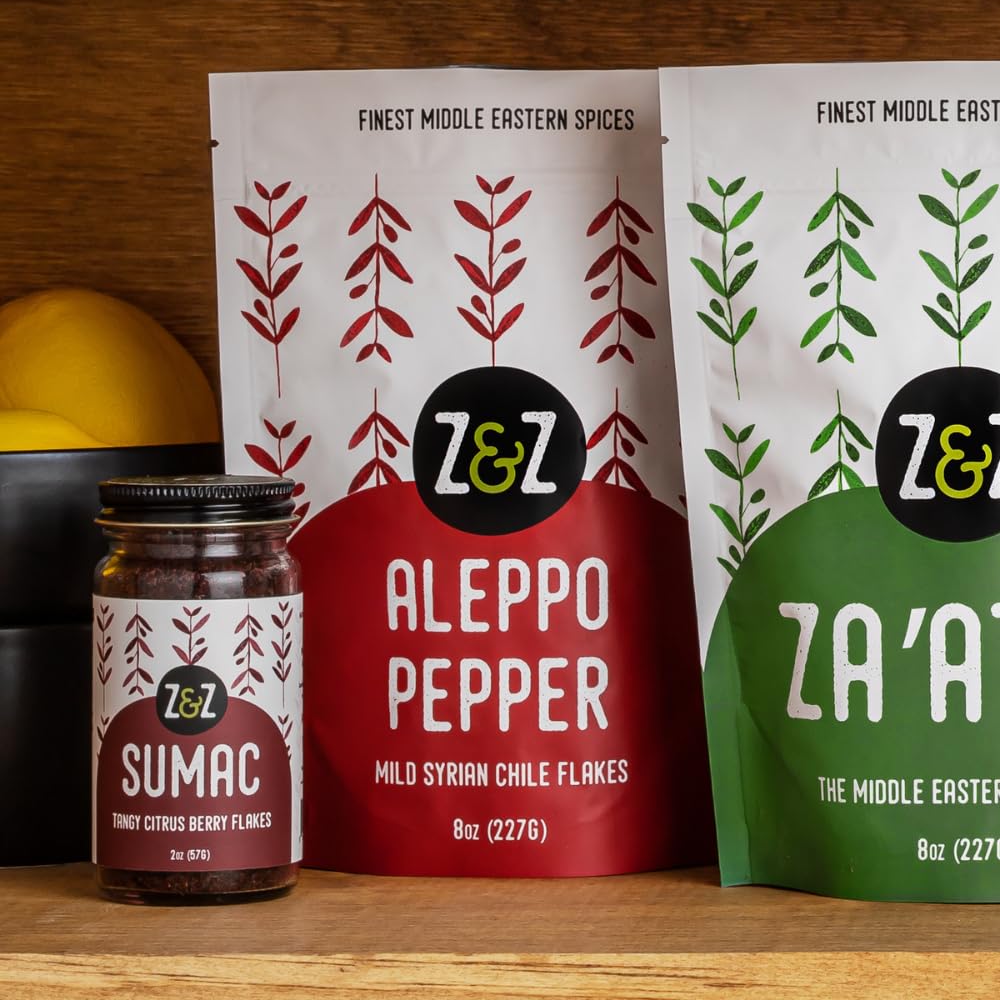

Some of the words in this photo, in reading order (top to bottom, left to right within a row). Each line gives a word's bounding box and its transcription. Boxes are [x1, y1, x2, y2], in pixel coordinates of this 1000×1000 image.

[359, 109, 414, 131] FINEST
[421, 108, 484, 129] MIDDLE
[492, 108, 567, 130] EASTERN
[574, 109, 635, 131] SPICES
[818, 101, 876, 123] FINEST
[884, 100, 949, 122] MIDDLE
[435, 411, 557, 494] Z&Z
[387, 557, 608, 632] ALEPPO
[165, 683, 216, 718] Z&Z
[389, 657, 608, 732] PEPPER
[123, 742, 259, 798] SUMAC
[376, 760, 416, 785] MILD
[424, 762, 488, 786] SYRIAN
[496, 762, 550, 786] CHILE
[558, 759, 627, 786] FLAKES
[819, 777, 846, 802] THE
[854, 779, 923, 804] MIDDLE
[113, 813, 140, 829] TANGY
[144, 815, 185, 831] CITRUS
[189, 815, 228, 831] BERRY
[232, 812, 271, 830] FLAKES
[454, 818, 479, 840] 8oz
[488, 819, 547, 843] (227G)
[170, 849, 184, 860] 2oz
[186, 848, 210, 861] (57G)
[918, 838, 945, 860] 8oz
